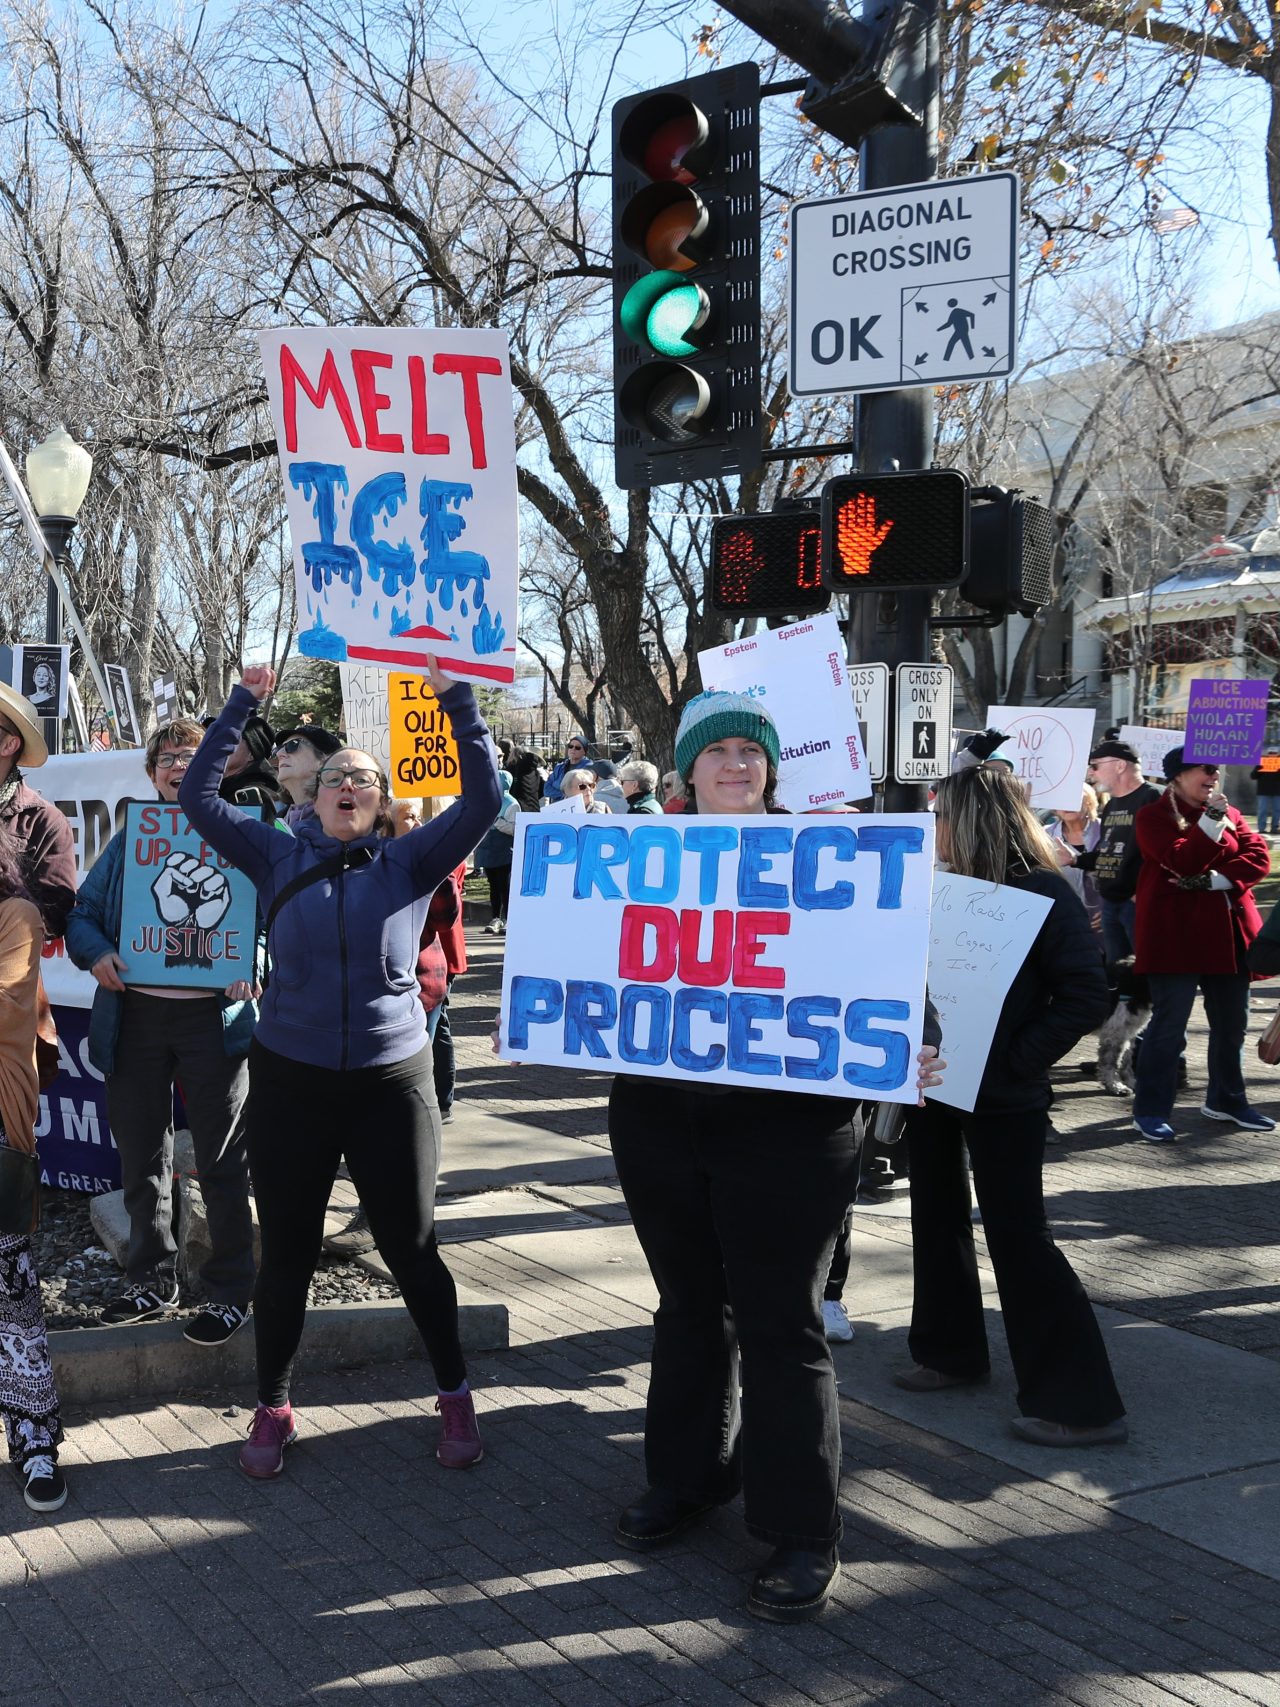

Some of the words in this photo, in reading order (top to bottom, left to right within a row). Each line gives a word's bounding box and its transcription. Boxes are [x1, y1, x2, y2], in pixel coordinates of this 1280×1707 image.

[832, 196, 972, 238] DIAGONAL
[832, 236, 972, 277] CROSSING
[810, 314, 885, 366] OK
[279, 343, 503, 470] MELT
[288, 461, 491, 611] ICE
[777, 623, 814, 641] Epstein
[723, 641, 758, 658] Epstein
[826, 651, 842, 686] Epstein
[850, 671, 875, 686] OSS
[908, 670, 943, 686] CROSS
[348, 666, 387, 697] KEE
[399, 680, 435, 700] IC
[1212, 681, 1242, 695] ICE
[911, 688, 939, 703] ONLY
[1192, 697, 1266, 710] ABDUCTIONS
[404, 708, 447, 733] OUT
[918, 705, 932, 719] ON
[1190, 712, 1254, 727] VIOLATE
[415, 735, 447, 754] FOR
[1018, 727, 1043, 750] NO
[1194, 729, 1249, 741] HUMAN
[779, 739, 831, 761] titution
[845, 735, 860, 770] Epstein
[397, 755, 457, 785] GOOD
[904, 762, 943, 777] SIGNAL
[1020, 757, 1042, 778] ICE
[808, 789, 845, 805] Epstein
[135, 838, 171, 866] UP
[520, 823, 924, 911] PROTECT
[132, 925, 241, 961] JUSTICE
[618, 904, 791, 988] DUE
[507, 975, 910, 1091] PROCESS
[58, 1170, 112, 1193] GREAT
